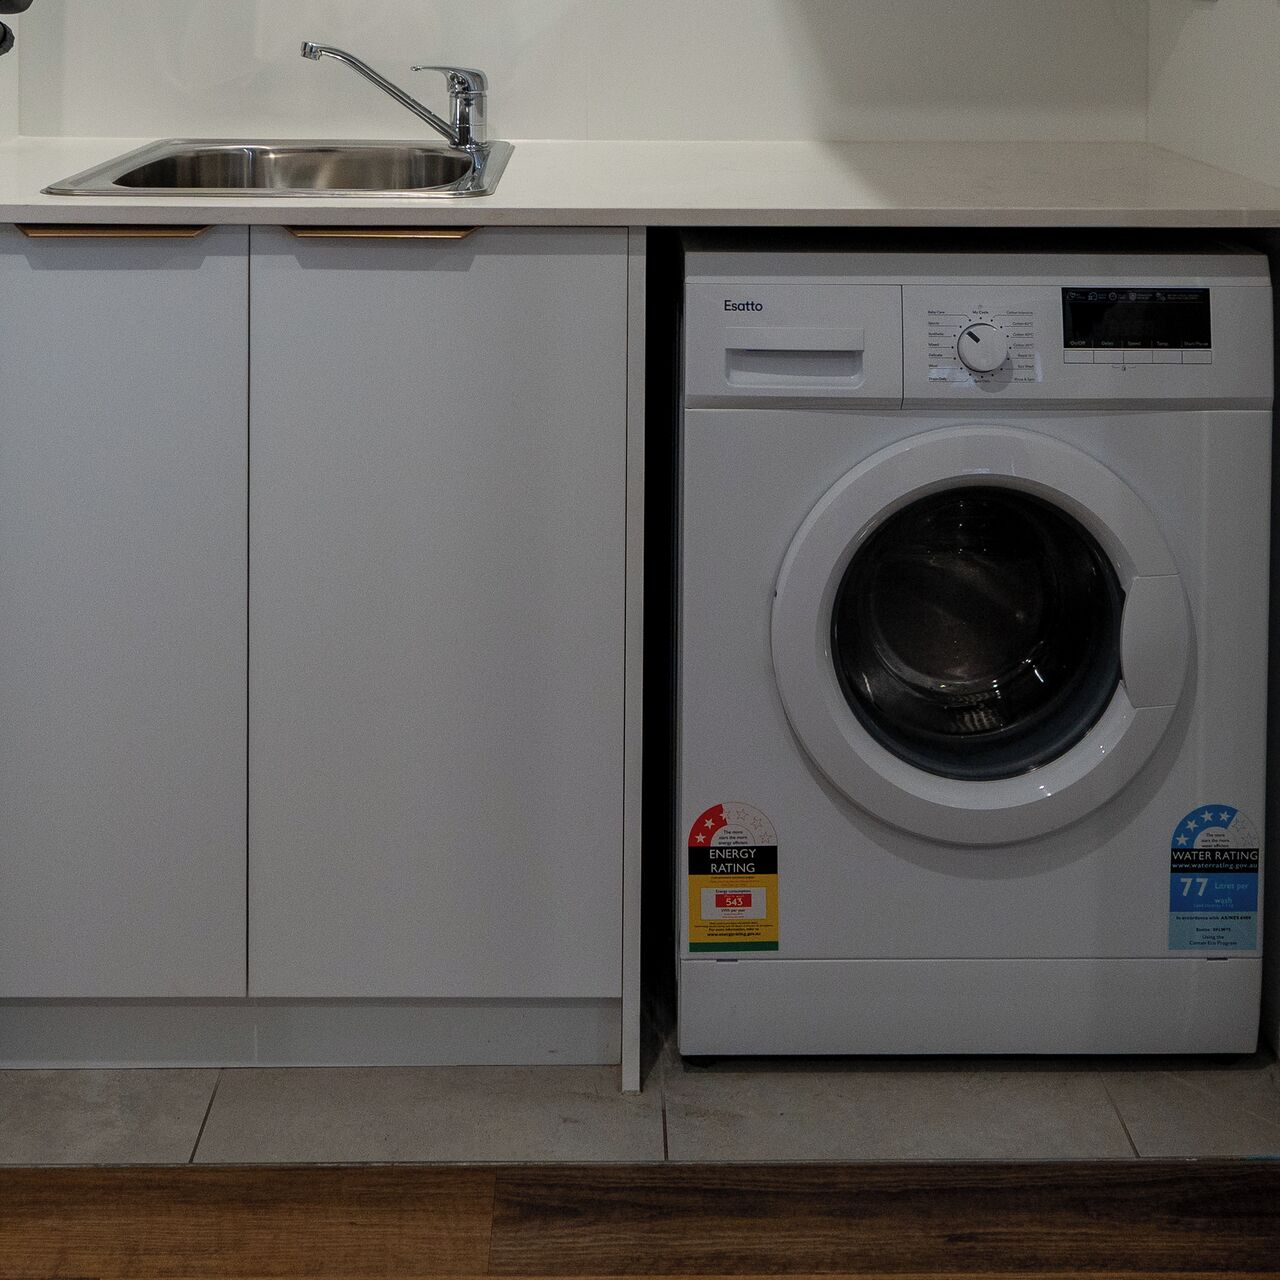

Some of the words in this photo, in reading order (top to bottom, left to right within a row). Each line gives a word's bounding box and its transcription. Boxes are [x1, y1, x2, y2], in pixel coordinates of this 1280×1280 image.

[724, 300, 763, 312] Esatto
[709, 848, 757, 859] ENERGY
[1172, 851, 1212, 860] WATER
[1214, 851, 1258, 860] RATING
[710, 864, 755, 873] RATING
[1180, 878, 1208, 896] 77
[725, 898, 743, 906] 543
